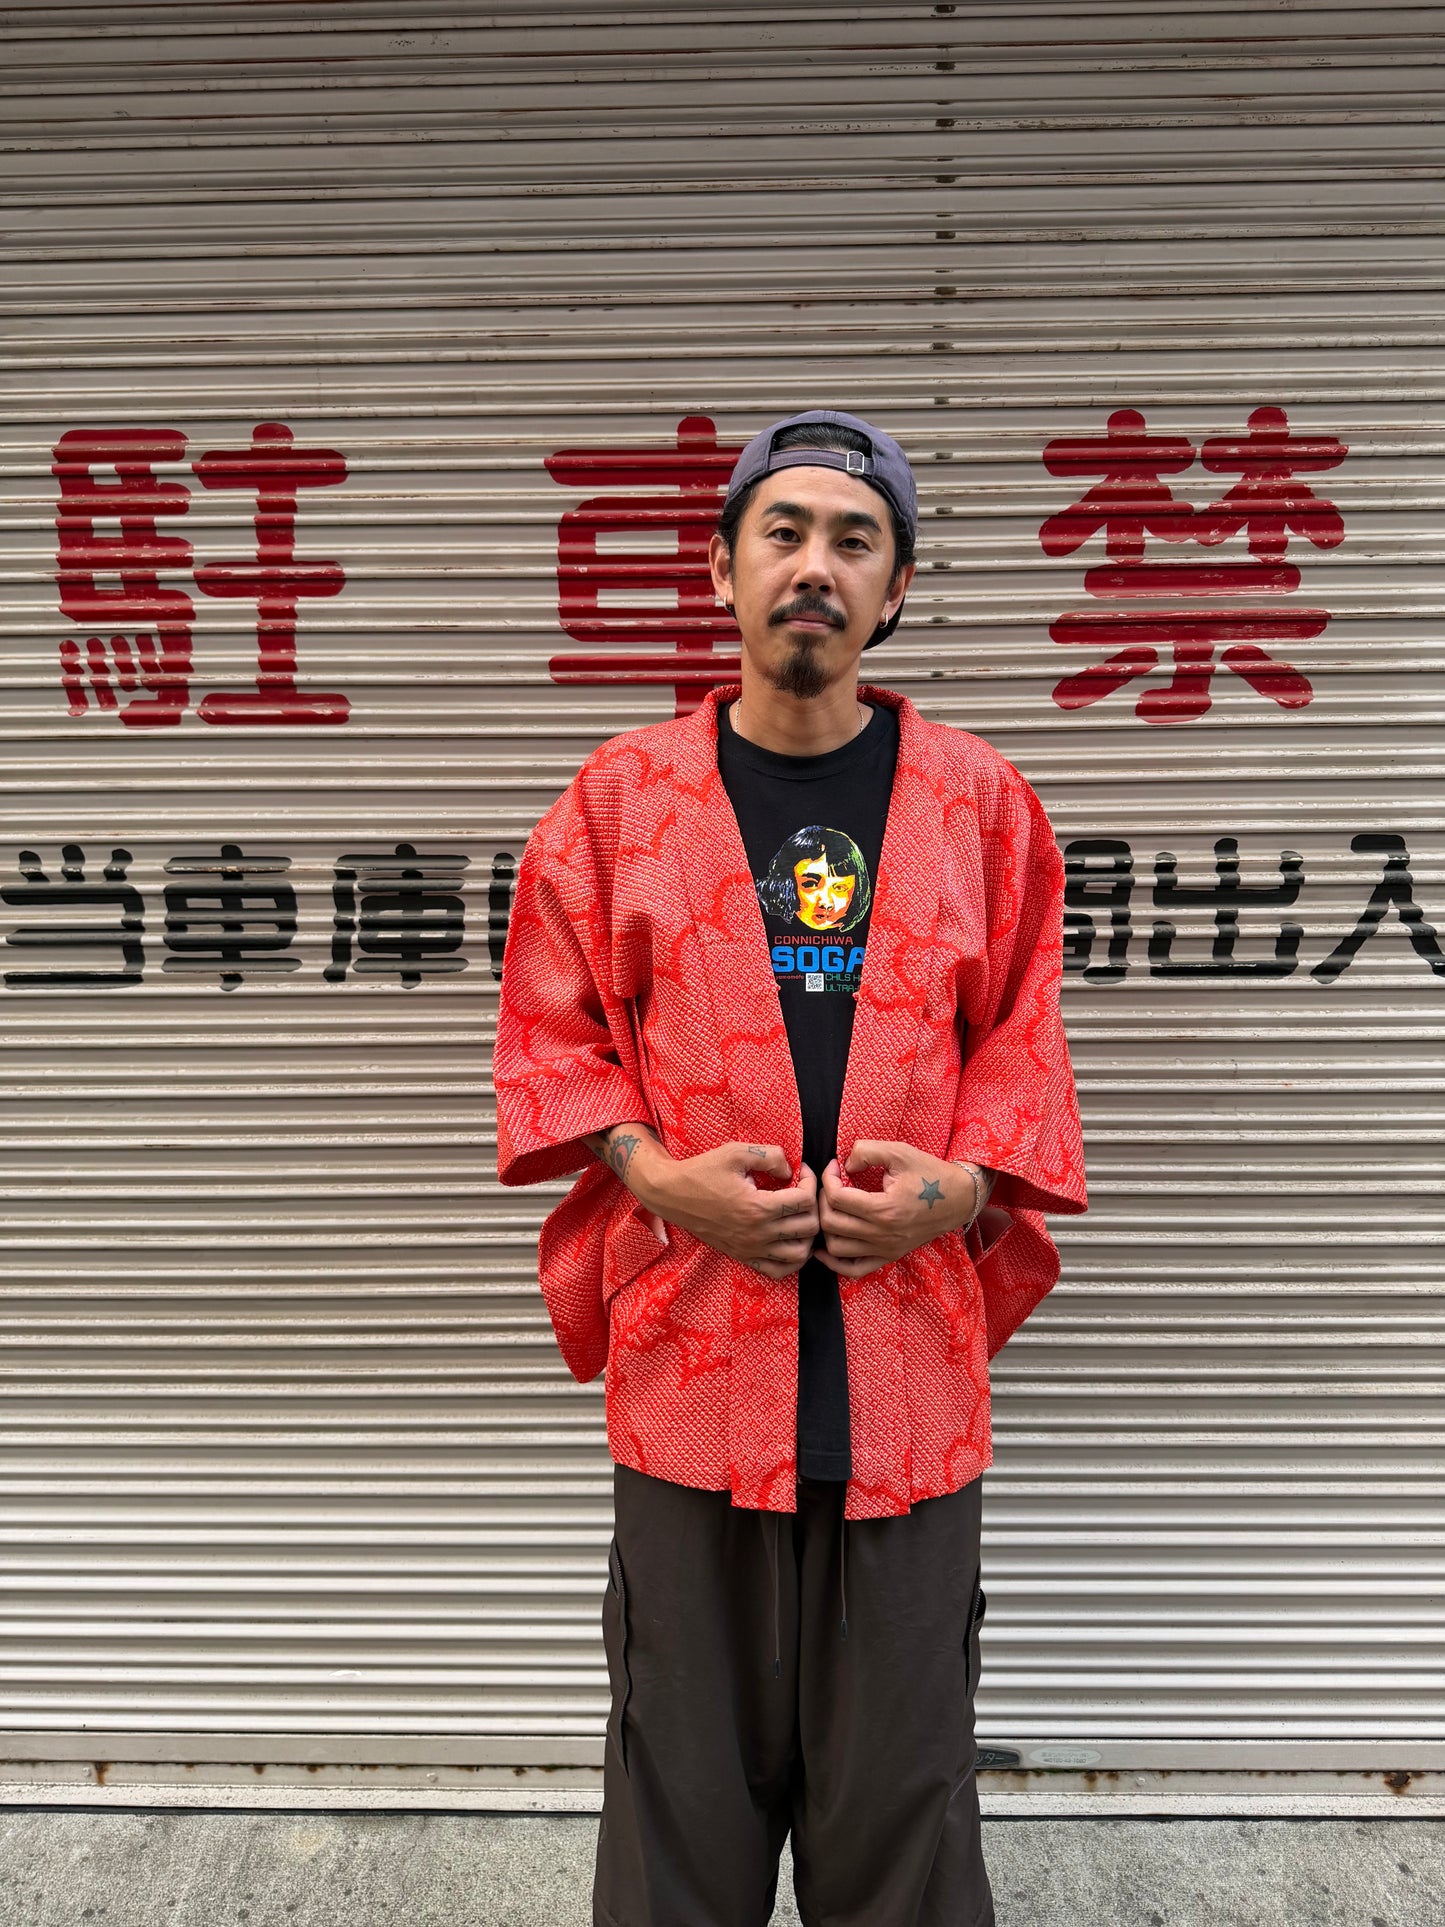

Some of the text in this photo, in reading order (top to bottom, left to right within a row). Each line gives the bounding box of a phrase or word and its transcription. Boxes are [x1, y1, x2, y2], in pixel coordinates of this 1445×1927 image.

[0, 843, 517, 991] 当車庫
[774, 935, 854, 945] CONNICHIWA
